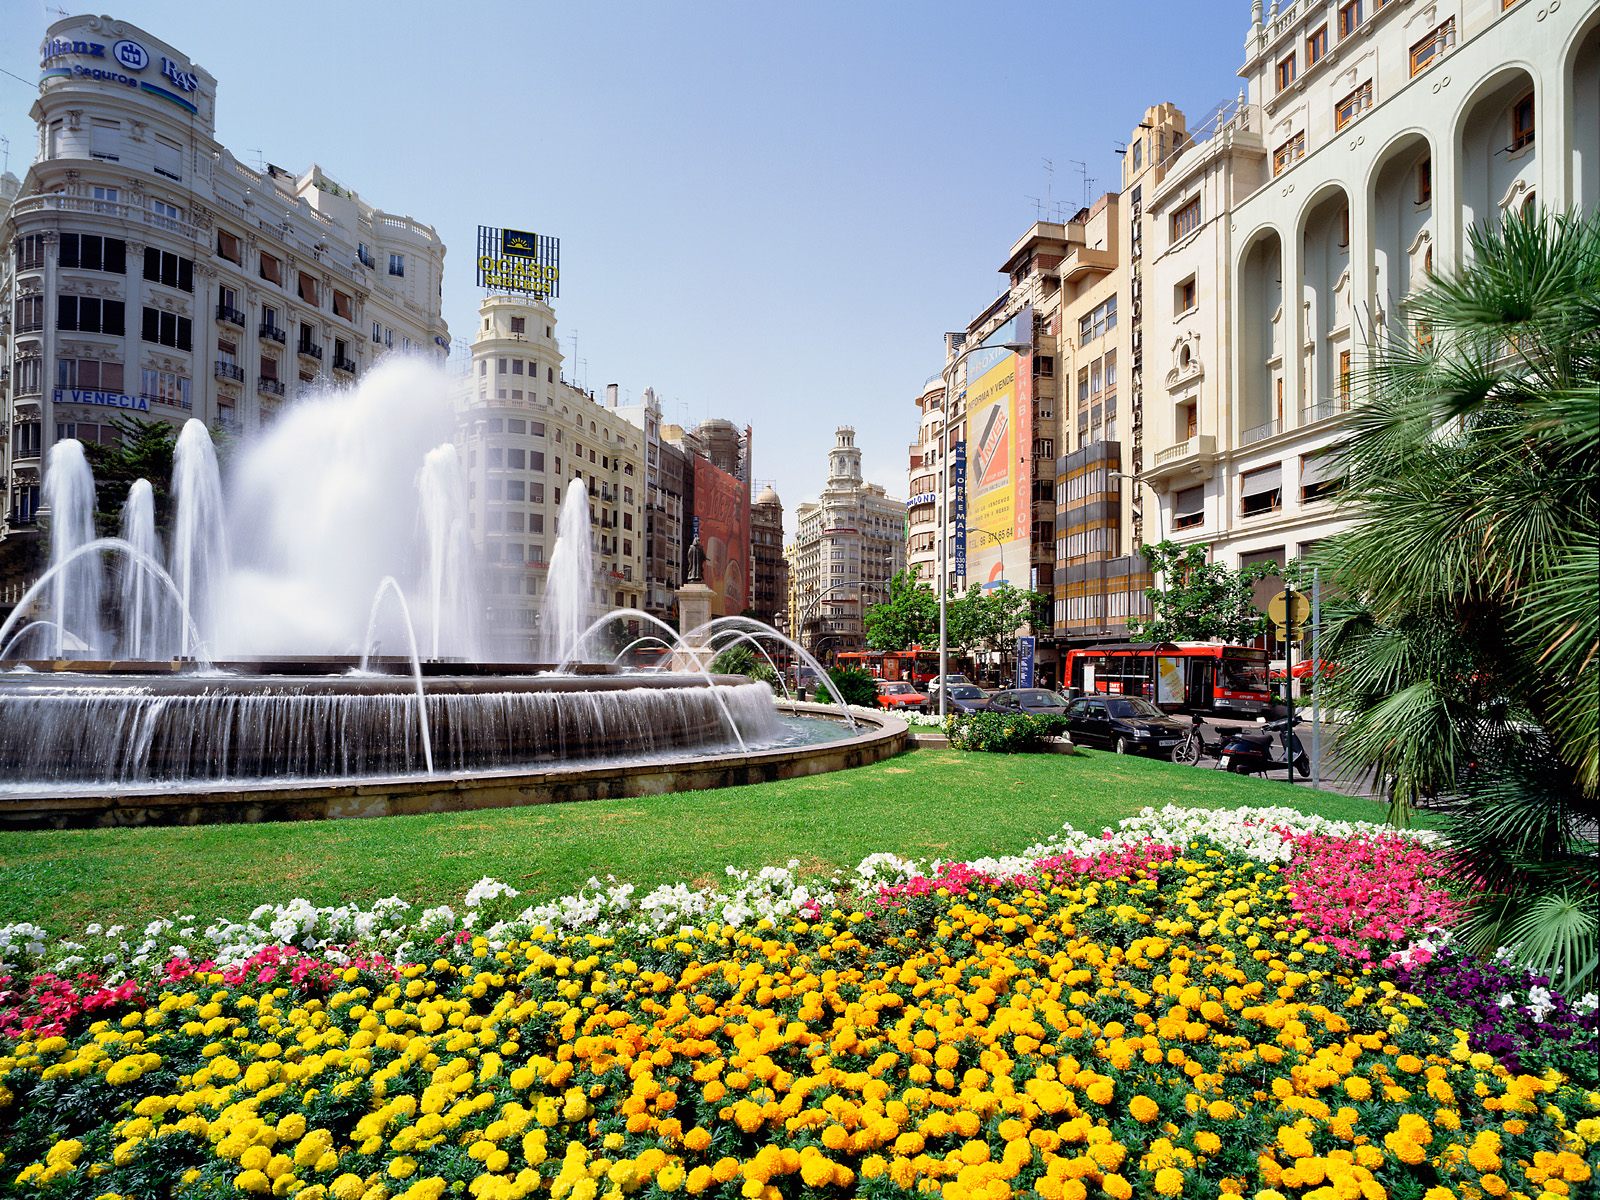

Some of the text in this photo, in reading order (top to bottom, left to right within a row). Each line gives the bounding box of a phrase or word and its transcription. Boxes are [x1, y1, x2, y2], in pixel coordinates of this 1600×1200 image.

[44, 39, 105, 57] llianz
[73, 65, 138, 88] Seguros
[161, 57, 199, 92] RAS
[478, 255, 559, 281] OCASO
[485, 274, 551, 293] SEGUROS
[995, 372, 1014, 392] VENDE
[54, 390, 147, 410] H VENECIA
[956, 468, 966, 538] TORREMAR
